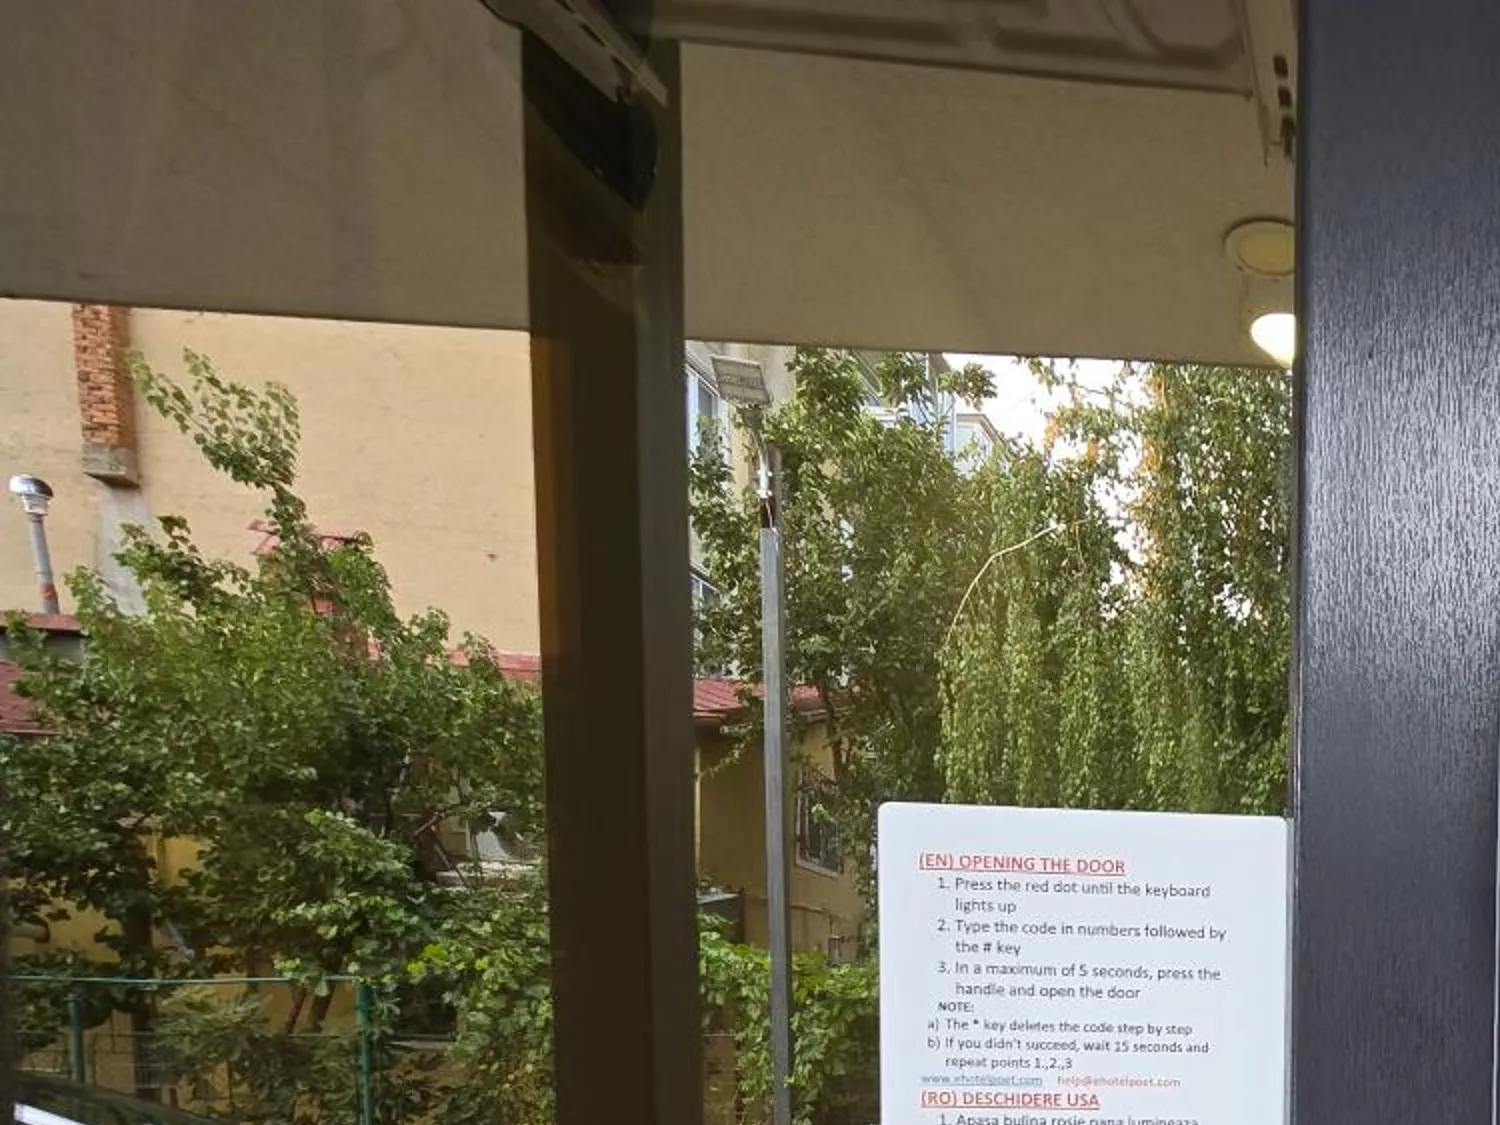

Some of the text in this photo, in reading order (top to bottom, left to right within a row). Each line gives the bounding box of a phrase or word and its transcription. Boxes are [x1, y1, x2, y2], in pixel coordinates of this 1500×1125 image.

[919, 853, 1125, 873] (EN) OPENING THE DOOR
[938, 877, 1210, 900] 1. Press the red dot until the keyboard
[955, 899, 1015, 915] lights up
[937, 919, 1226, 942] 2. Type the code in numbers followed by
[955, 940, 1020, 957] the # key
[955, 961, 968, 973] In
[974, 965, 981, 973] a
[986, 962, 1056, 975] maximum
[1061, 964, 1075, 976] of
[1079, 965, 1087, 976] 5
[1091, 965, 1152, 980] seconds,
[1157, 970, 1193, 982] press
[1197, 968, 1221, 980] the
[956, 982, 1140, 1000] handle and open the door
[938, 1002, 974, 1011] NOTE:
[945, 1019, 968, 1029] The
[984, 1020, 1005, 1033] key
[1009, 1020, 1054, 1031] deletes
[1058, 1021, 1079, 1032] the
[1083, 1022, 1112, 1032] code
[1117, 1023, 1142, 1036] step
[1147, 1024, 1161, 1036] by
[1165, 1024, 1191, 1037] step
[928, 1037, 940, 1049] b)
[945, 1037, 953, 1047] If
[958, 1040, 980, 1051] you
[1025, 1039, 1079, 1052] succeed,
[1083, 1040, 1110, 1051] wait
[1114, 1041, 1128, 1051] 15
[1133, 1041, 1182, 1052] seconds
[1186, 1042, 1208, 1053] and
[945, 1056, 987, 1069] repeat
[991, 1057, 1030, 1070] points
[921, 1091, 1099, 1107] (RO) DESCHIDERE USA
[939, 1114, 950, 1125] 1.
